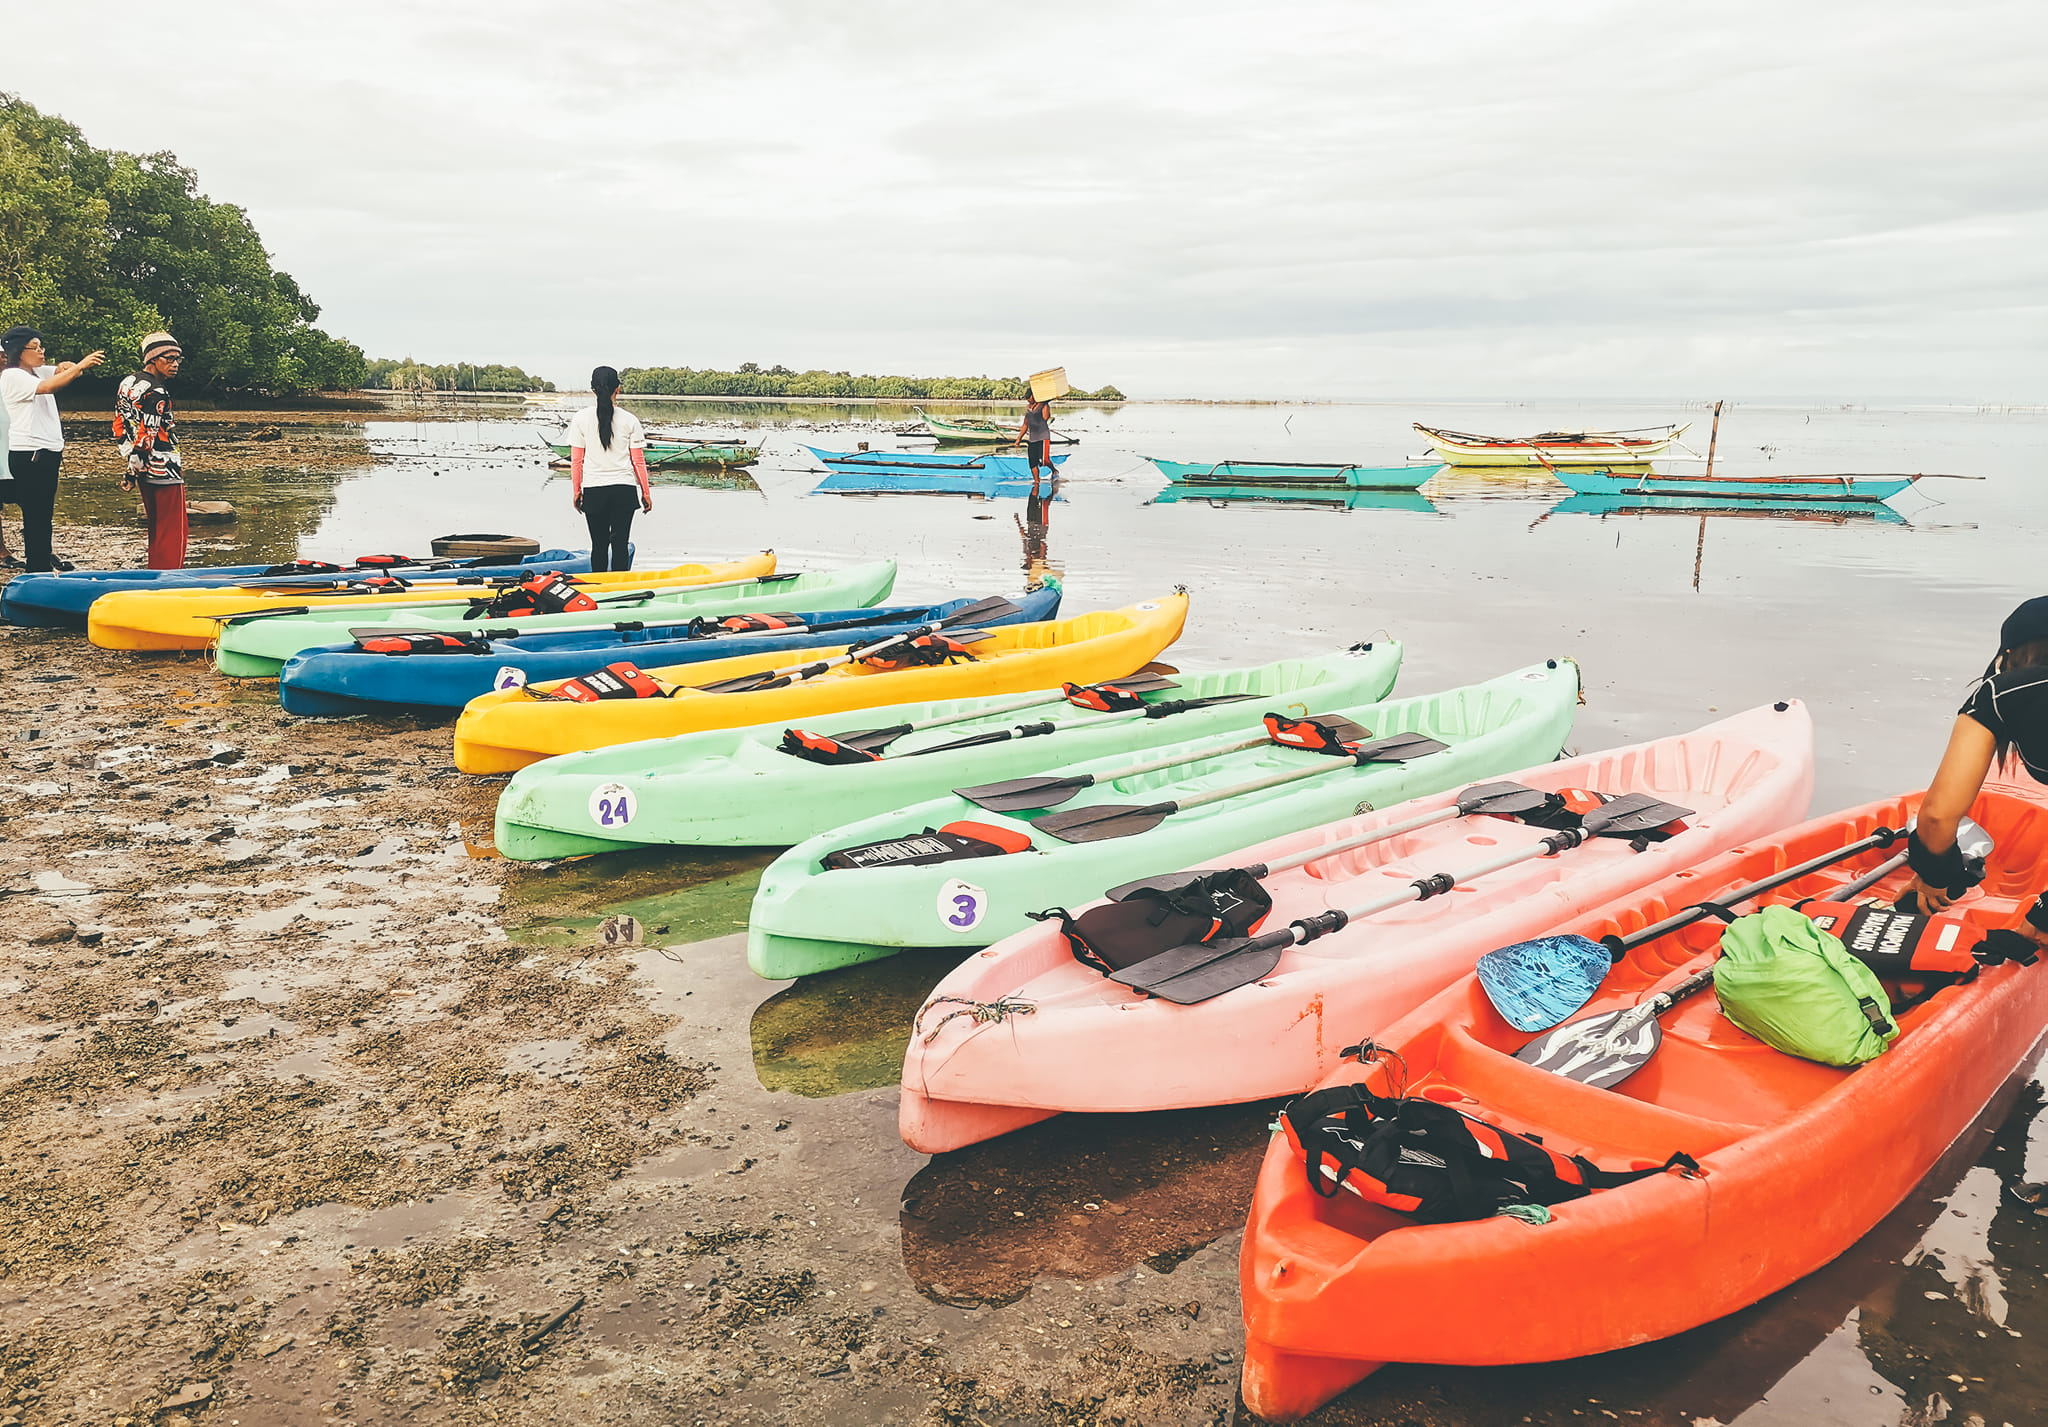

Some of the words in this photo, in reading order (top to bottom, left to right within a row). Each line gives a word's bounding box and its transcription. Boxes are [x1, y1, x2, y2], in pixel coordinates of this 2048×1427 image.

[599, 796, 629, 825] 24
[948, 894, 977, 926] 3
[1877, 914, 1916, 954] PALOMPON
